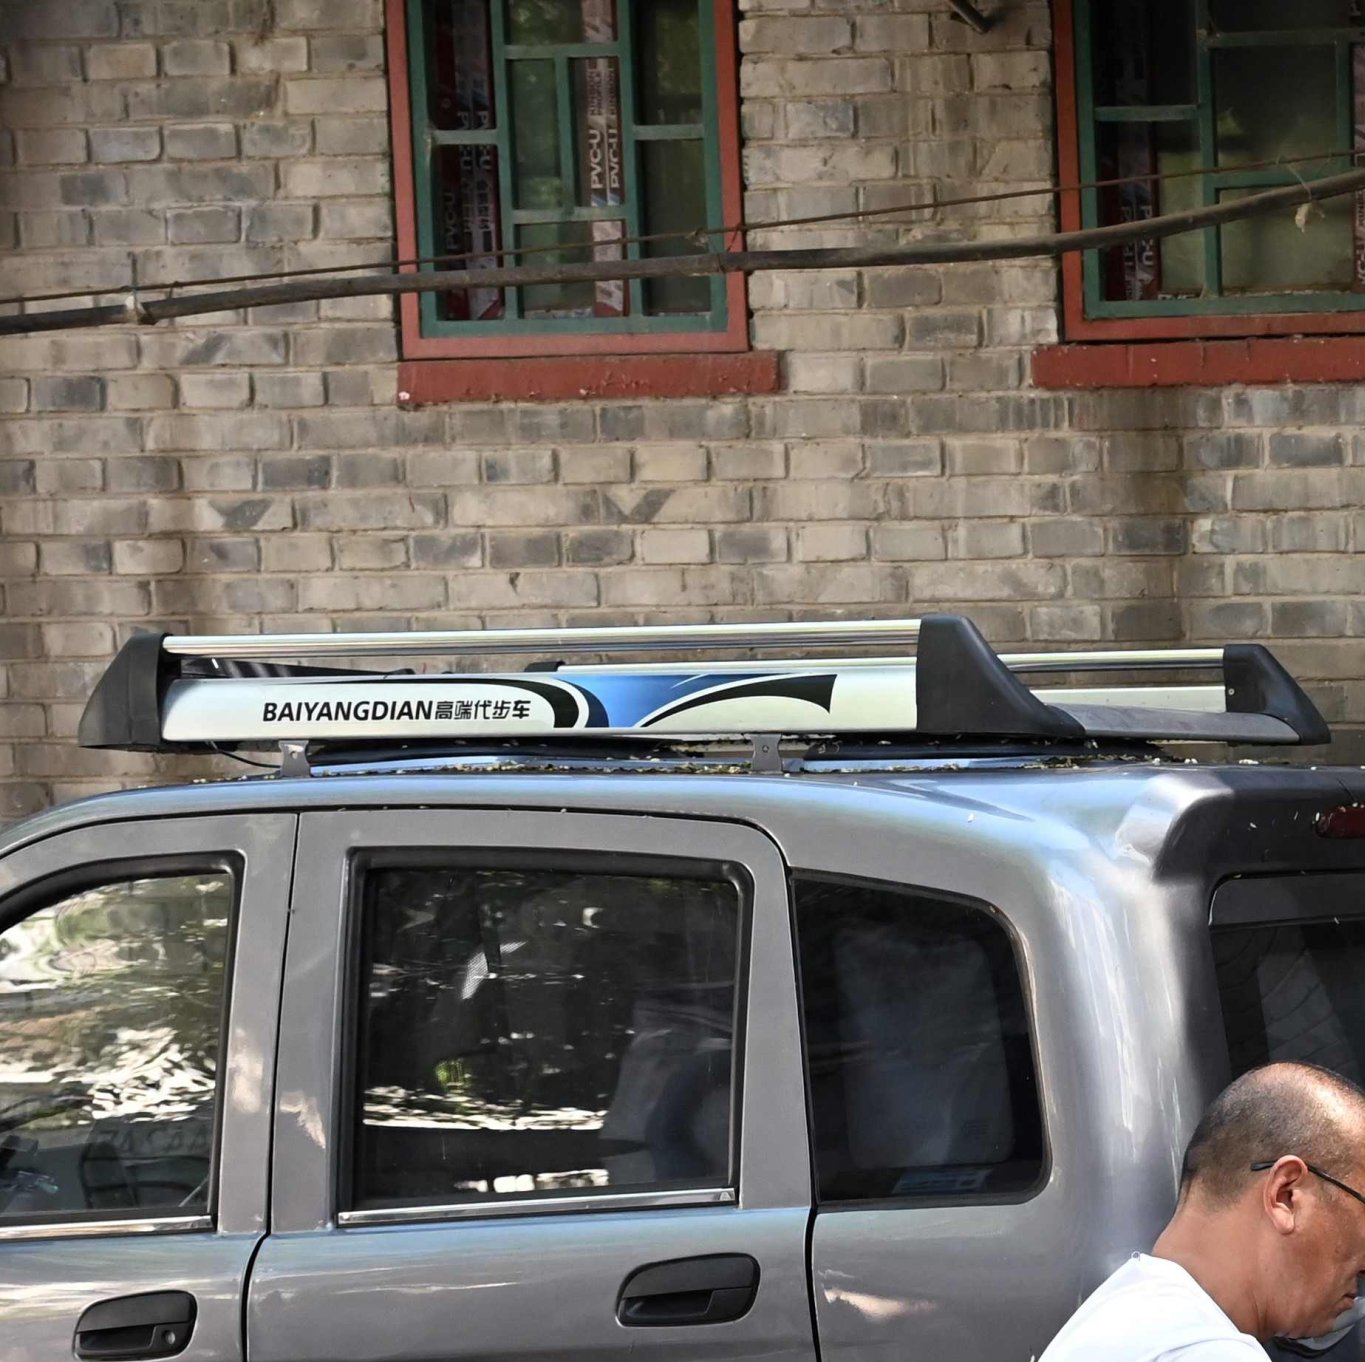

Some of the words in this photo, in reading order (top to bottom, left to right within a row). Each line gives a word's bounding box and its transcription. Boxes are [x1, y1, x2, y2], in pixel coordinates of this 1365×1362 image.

[588, 128, 603, 190] PVC-U
[262, 699, 433, 722] BAIYANGDIAN
[434, 699, 532, 720] 高端代步车
